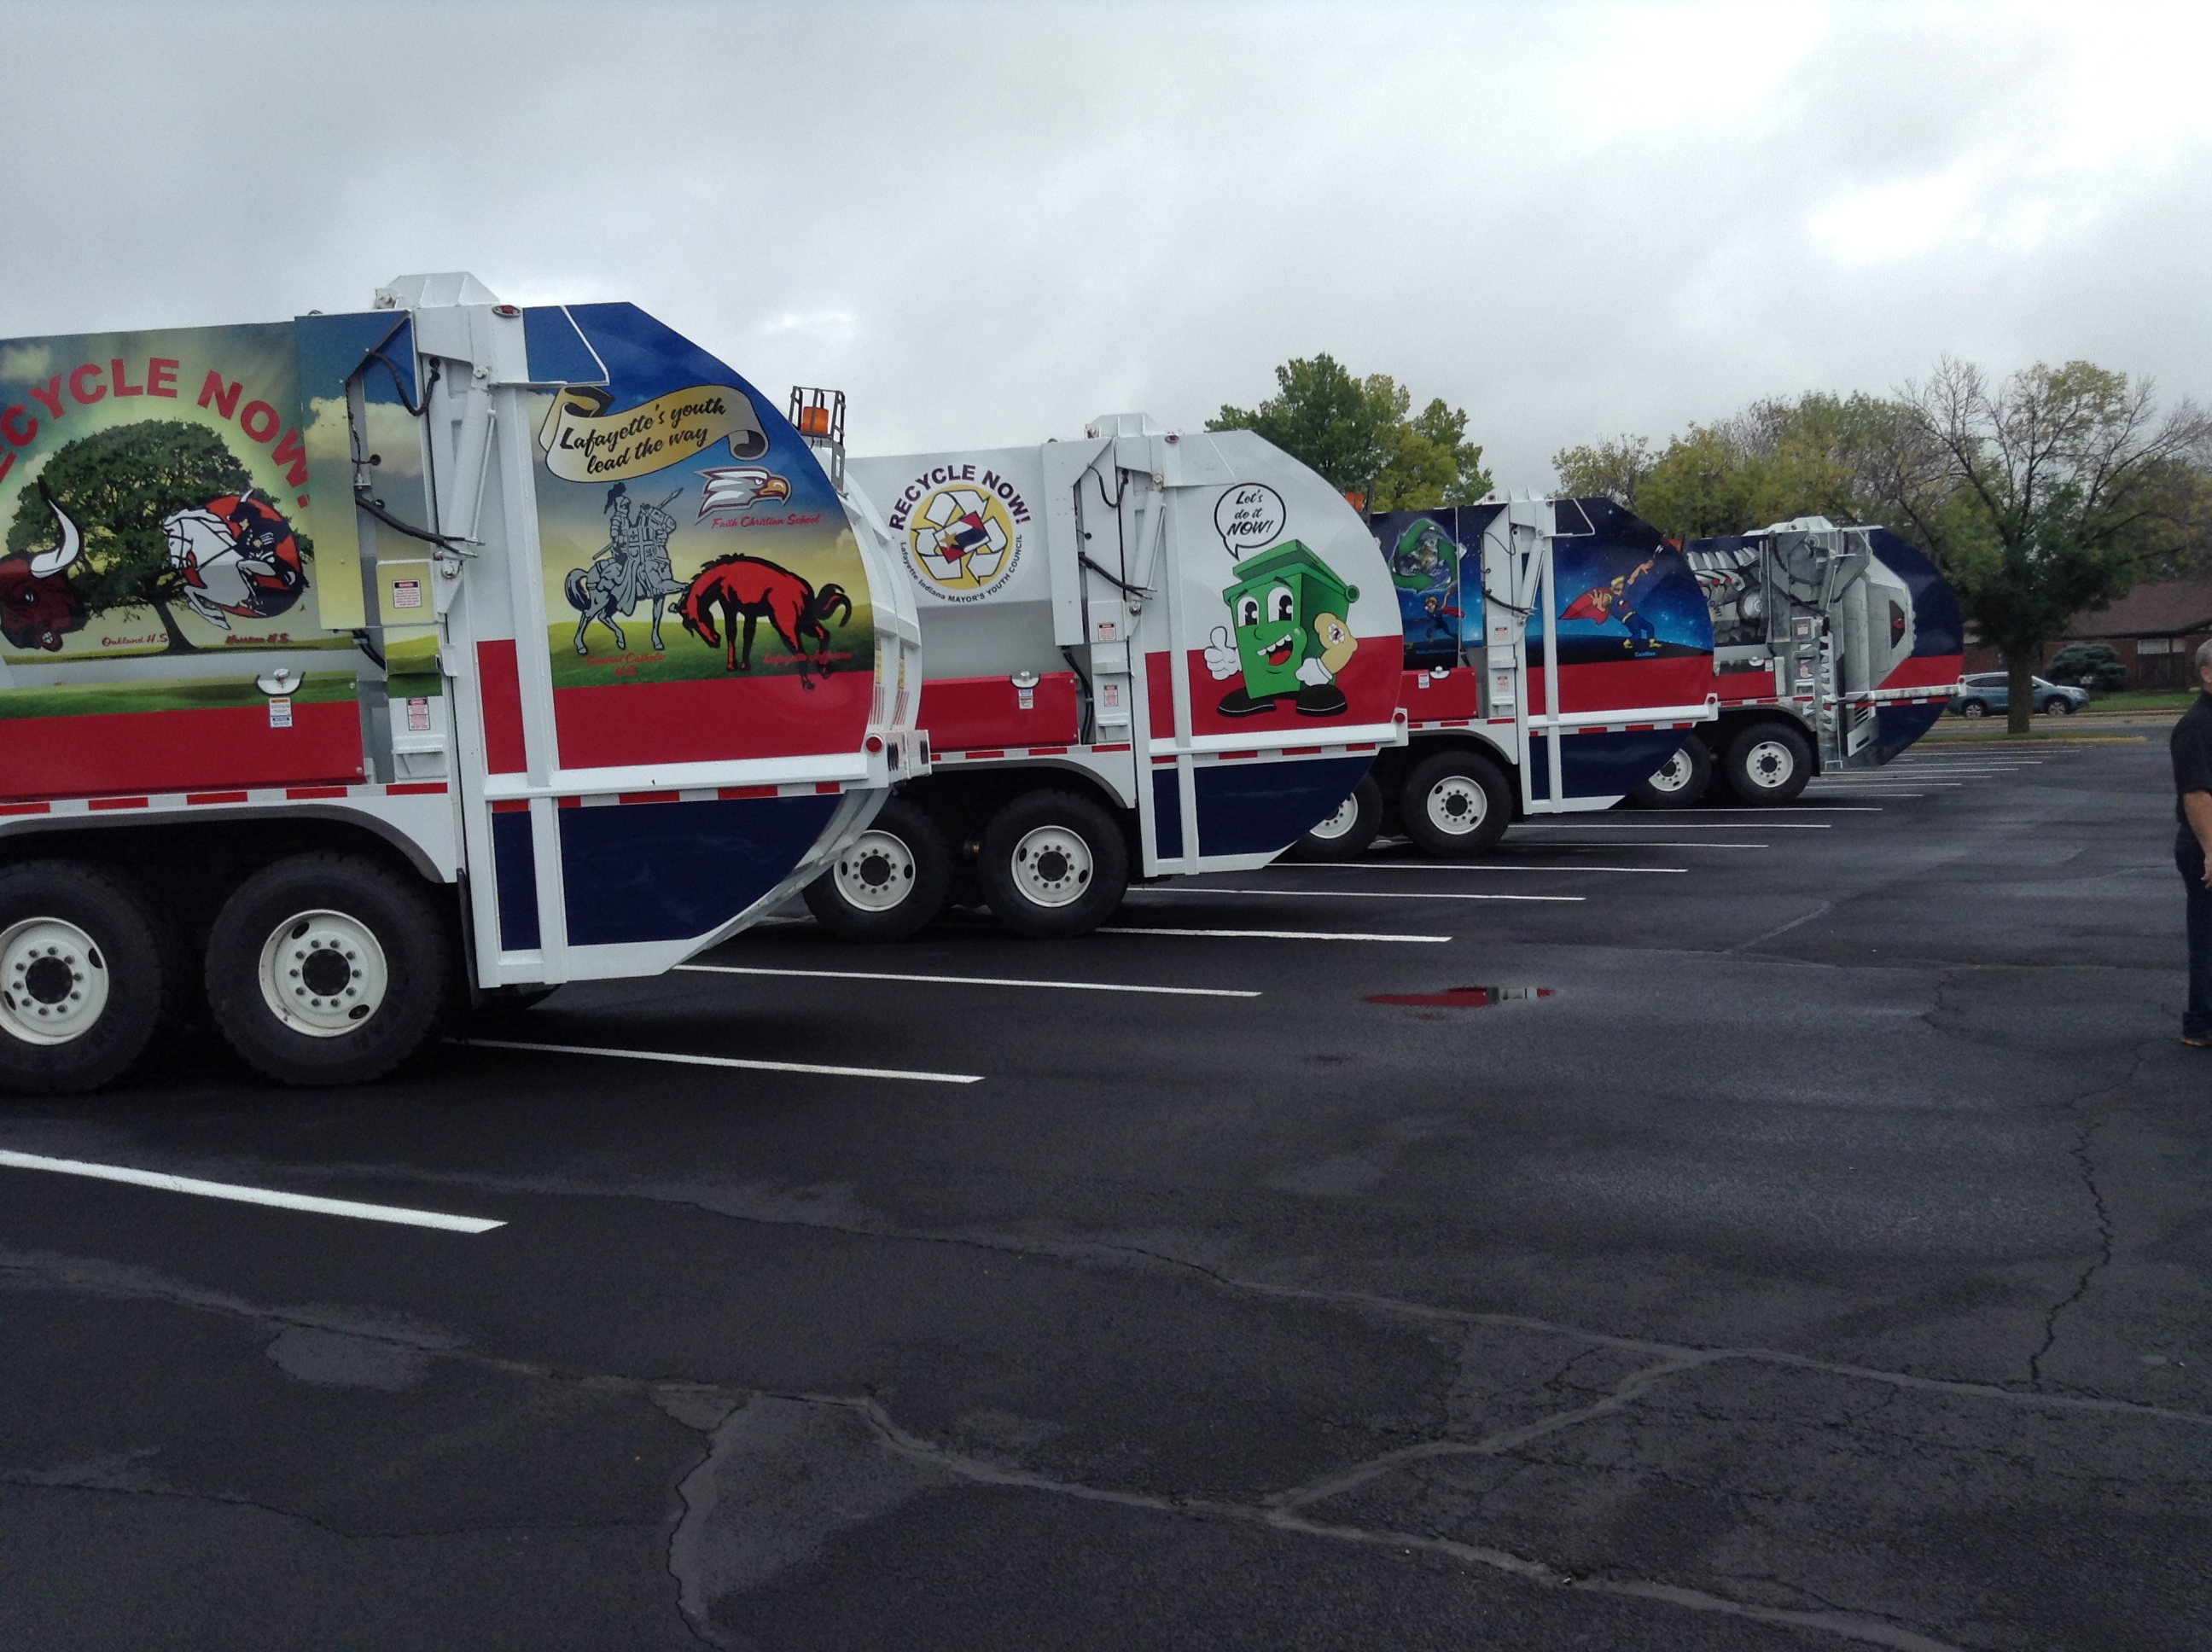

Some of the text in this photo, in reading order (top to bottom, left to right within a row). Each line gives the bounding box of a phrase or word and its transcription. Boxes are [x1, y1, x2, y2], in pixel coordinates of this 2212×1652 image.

[560, 398, 726, 457] Lafayette's youth
[587, 428, 707, 474] lead the way
[888, 464, 1031, 531] RECYCLE NOW!
[1236, 489, 1263, 504] Let's
[741, 515, 783, 527] Christian
[787, 513, 821, 526] School
[1234, 508, 1262, 520] do it
[1226, 520, 1274, 537] NOW!
[900, 534, 1022, 603] Lafayette Indiana MAYOR'S YOUTH COUNCIL
[102, 637, 144, 647] Oakland
